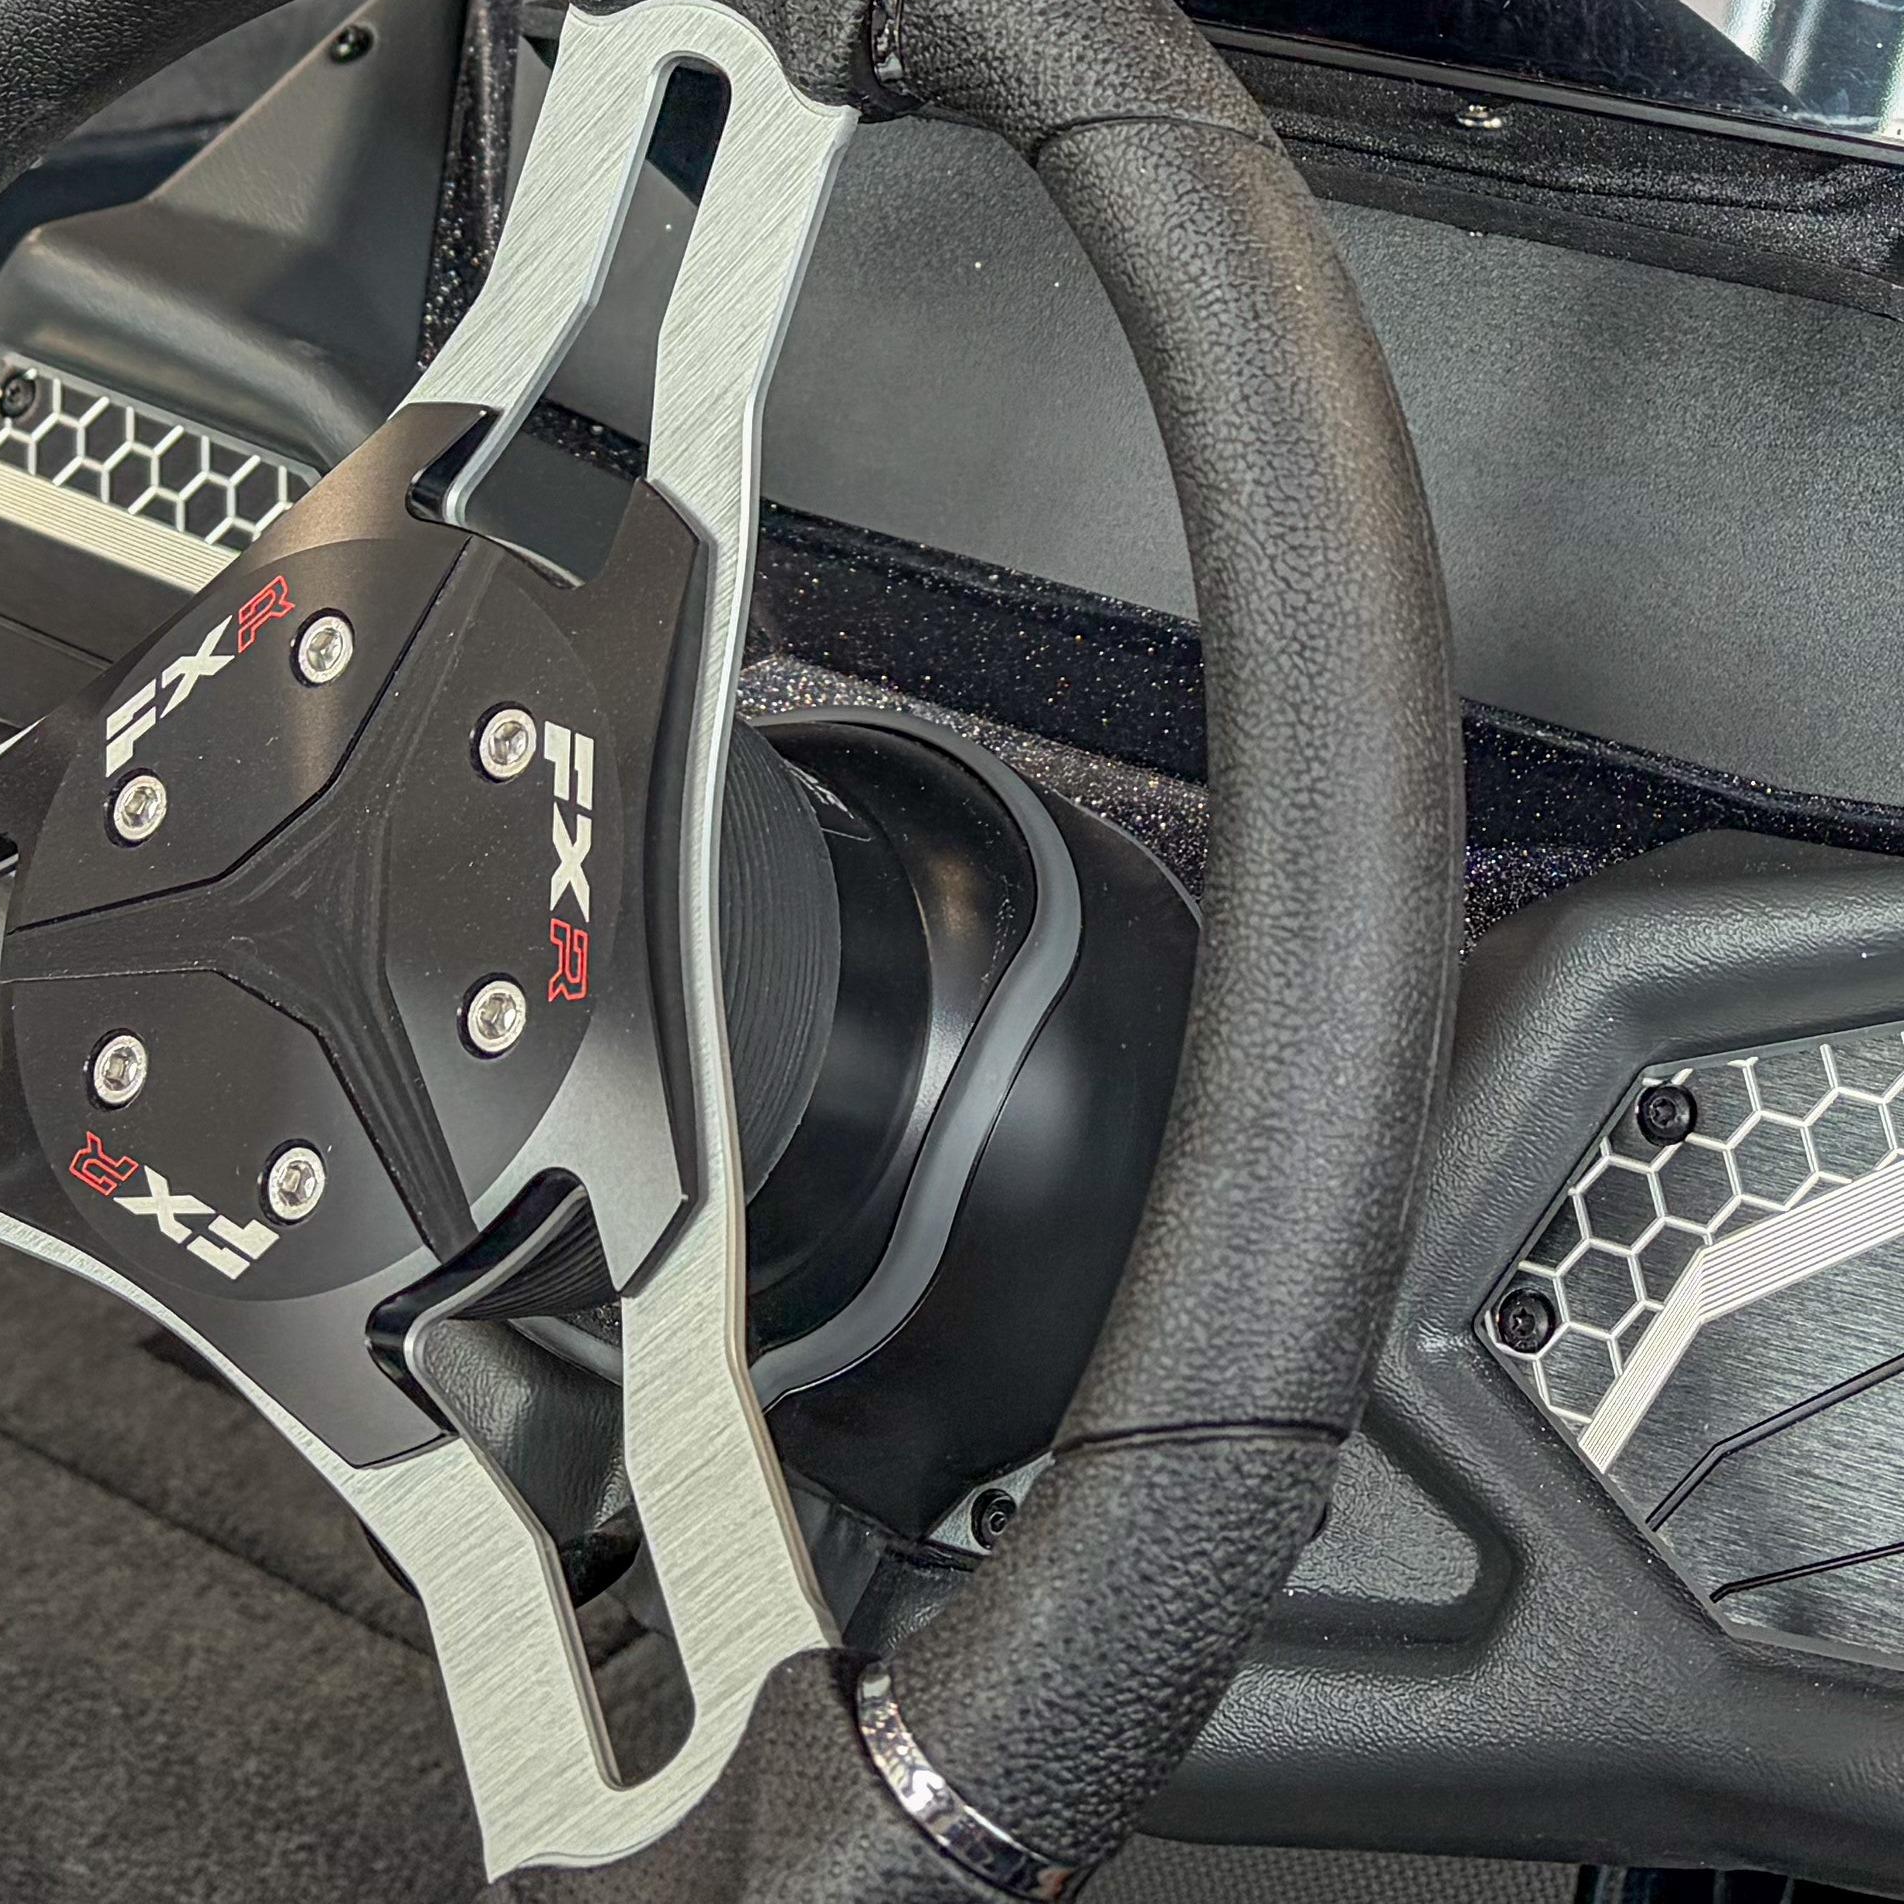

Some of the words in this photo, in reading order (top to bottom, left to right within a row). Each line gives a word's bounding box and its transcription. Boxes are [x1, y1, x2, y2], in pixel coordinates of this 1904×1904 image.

[105, 575, 295, 778] FXR
[543, 720, 595, 1003] FXR
[69, 1132, 280, 1281] FXR
